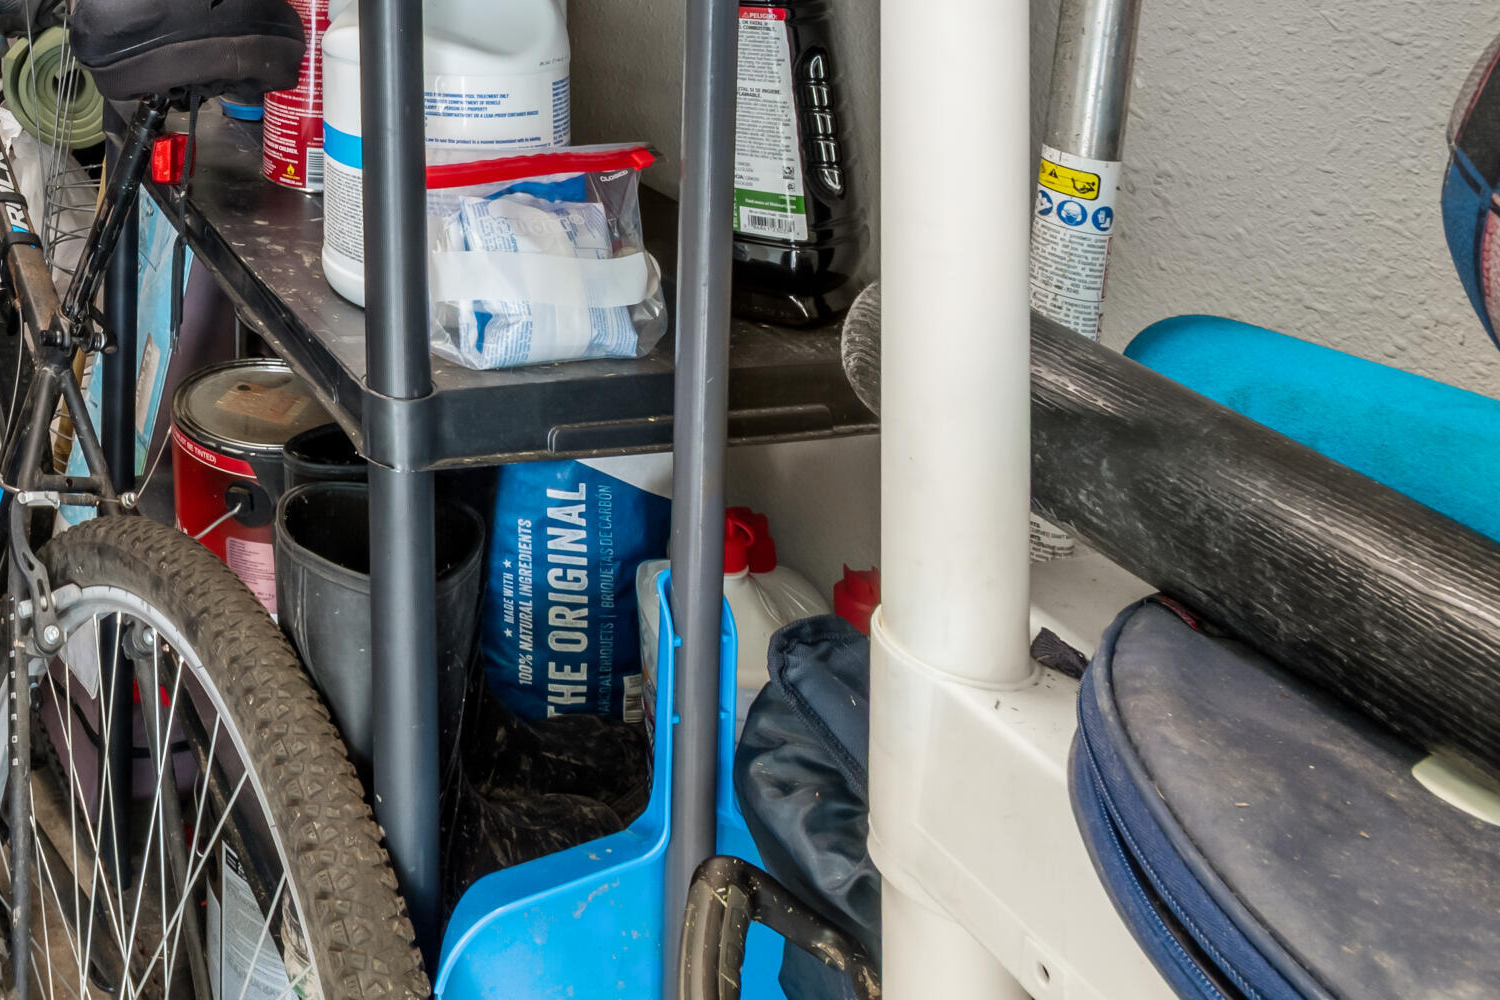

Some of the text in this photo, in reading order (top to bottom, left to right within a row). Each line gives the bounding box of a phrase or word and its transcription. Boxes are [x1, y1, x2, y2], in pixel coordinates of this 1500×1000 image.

[194, 445, 217, 465] TINTED)
[600, 531, 613, 547] DE
[502, 572, 514, 624] MADE WITH
[518, 518, 533, 685] 100% NATURAL INGREDIENTS
[546, 482, 589, 719] THE ORIGINAL
